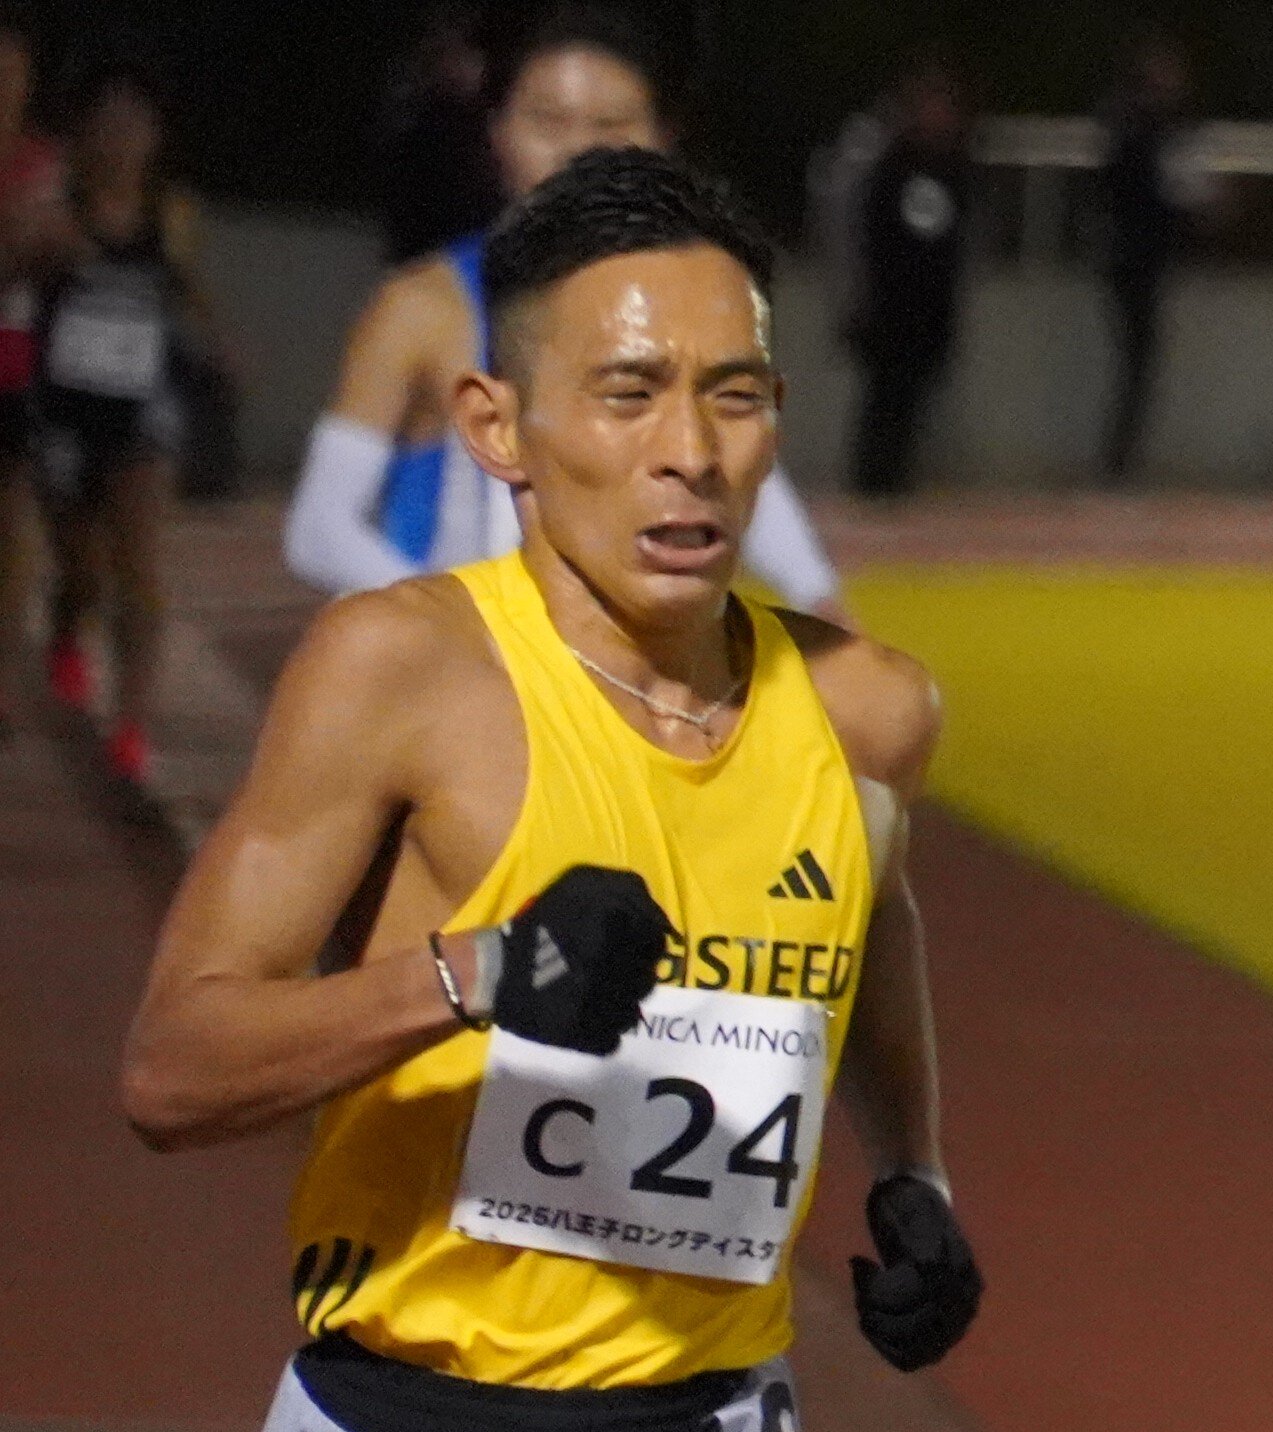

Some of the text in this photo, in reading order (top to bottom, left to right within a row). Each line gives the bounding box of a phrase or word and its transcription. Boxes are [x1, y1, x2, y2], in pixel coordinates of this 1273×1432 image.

[654, 934, 853, 1000] GISTEED
[633, 1013, 702, 1045] NICA
[521, 1076, 805, 1209] C 24
